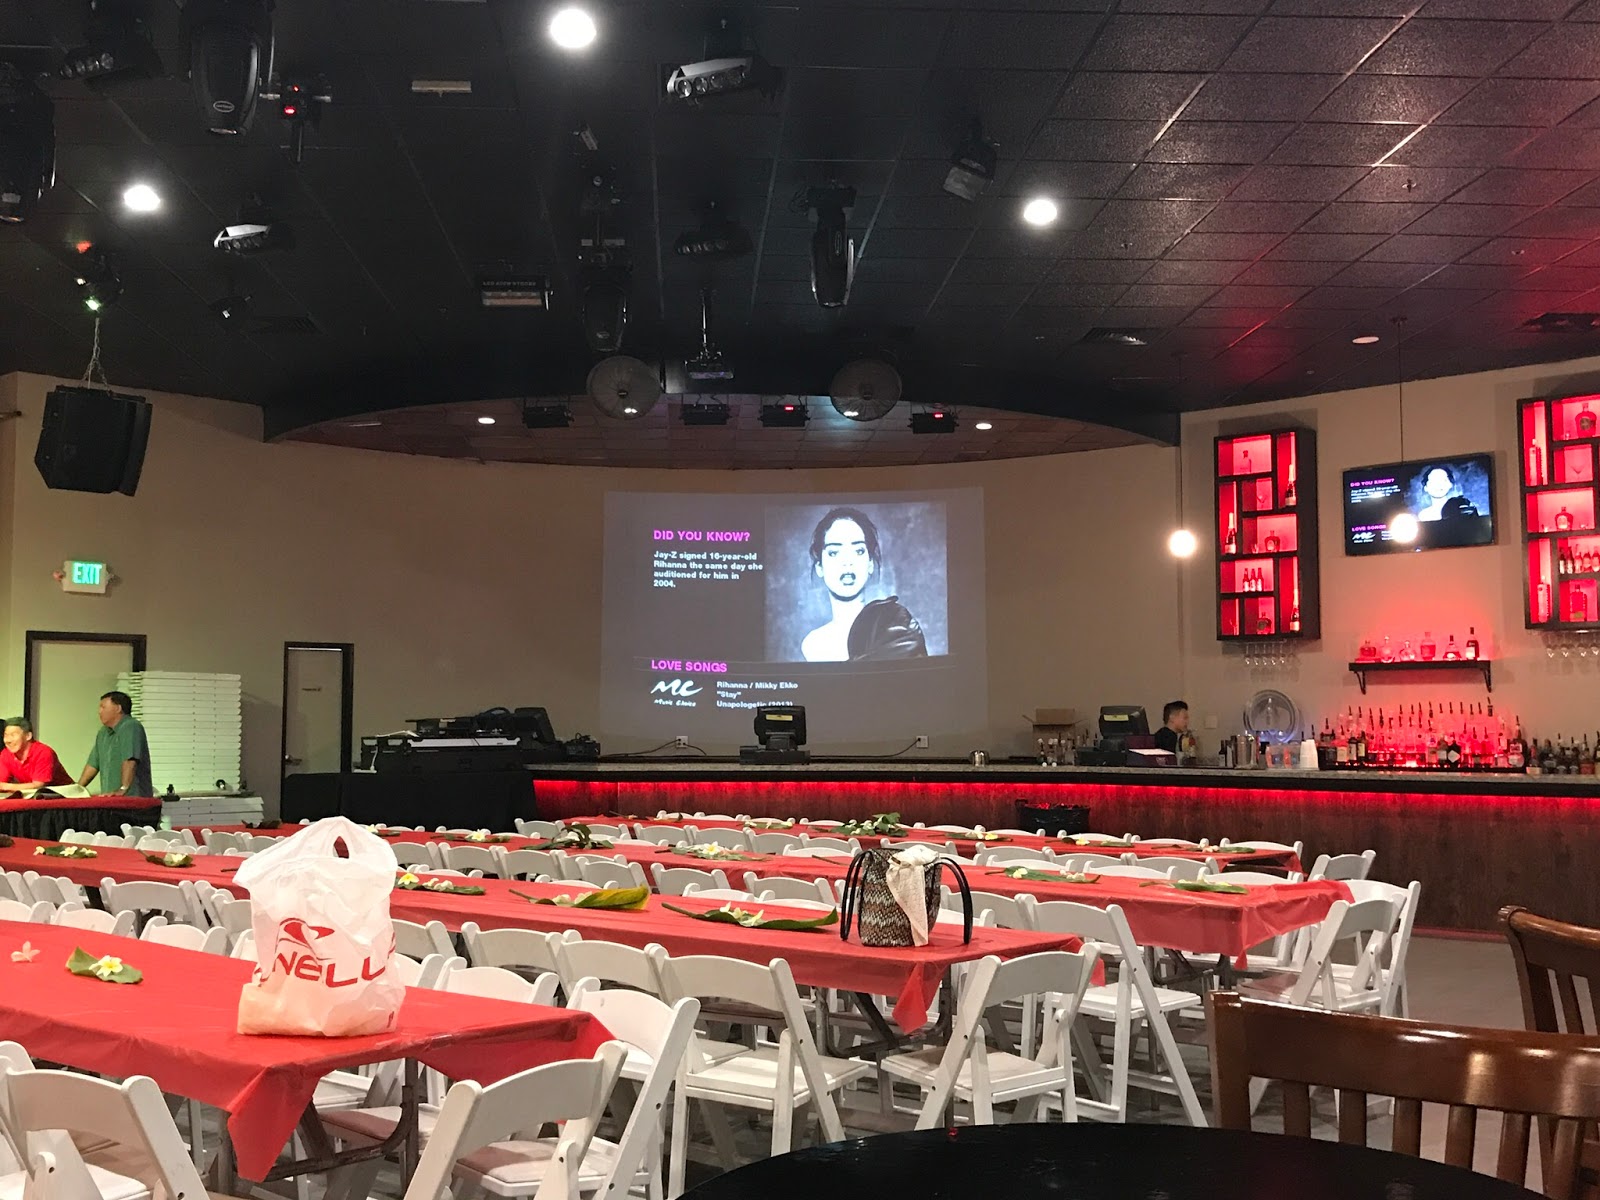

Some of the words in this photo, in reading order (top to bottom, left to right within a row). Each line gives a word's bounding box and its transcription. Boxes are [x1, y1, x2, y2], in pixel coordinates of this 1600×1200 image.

[653, 530, 674, 540] DID
[678, 530, 702, 541] YOU
[706, 531, 751, 542] KNOW?
[653, 551, 678, 560] Jay-Z
[679, 552, 707, 561] signed
[709, 552, 758, 562] 16-year-old
[653, 560, 687, 569] Rihanna
[689, 561, 703, 569] the
[730, 562, 746, 571] day
[748, 562, 764, 570] she
[73, 562, 103, 585] EXIT
[653, 570, 697, 579] auditioned
[699, 571, 711, 579] for
[713, 571, 729, 580] him
[731, 572, 740, 580] in
[653, 580, 676, 588] 2004.
[651, 660, 682, 671] LOVE
[685, 661, 728, 673] SONGS
[716, 680, 748, 689] Rihanna
[755, 681, 778, 690] Mikky
[779, 681, 799, 689] Ekko
[716, 690, 742, 699] "Stay"
